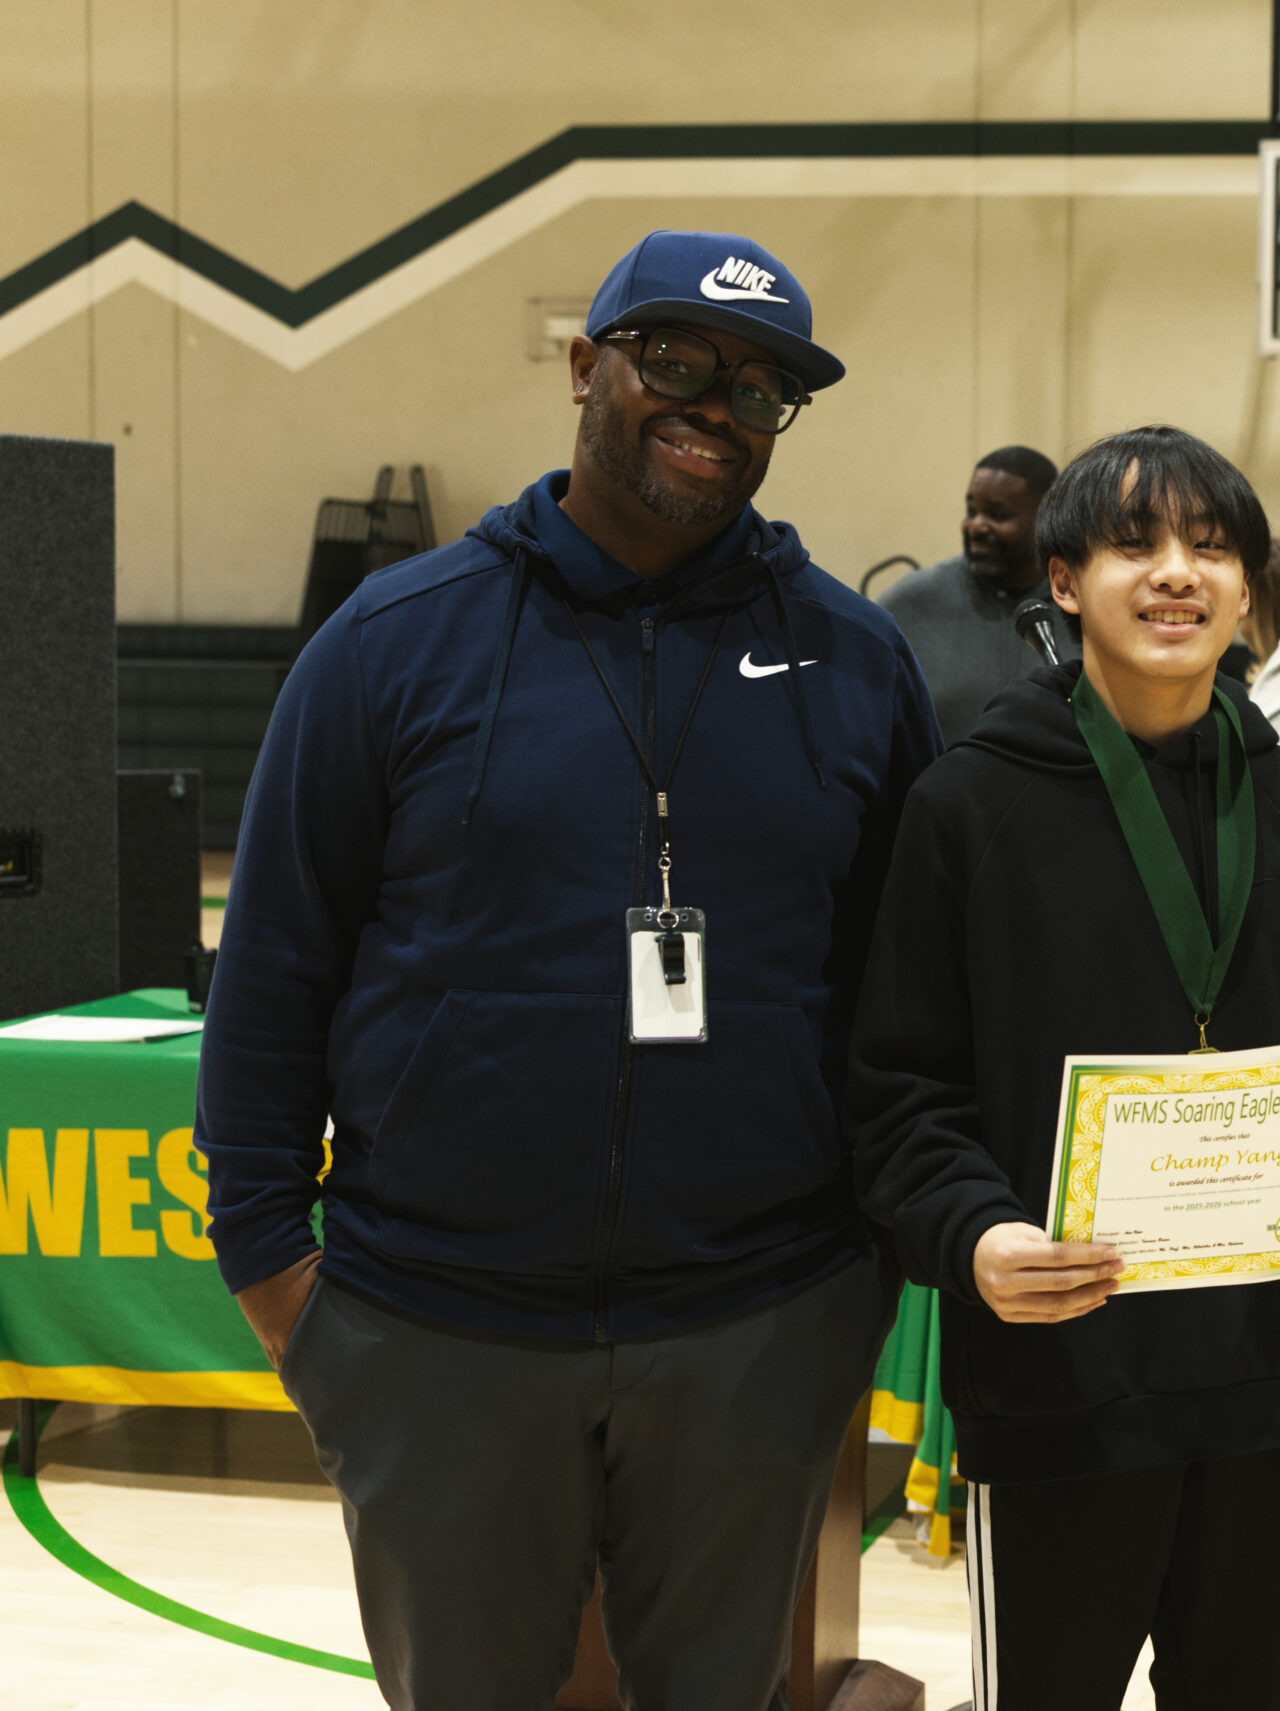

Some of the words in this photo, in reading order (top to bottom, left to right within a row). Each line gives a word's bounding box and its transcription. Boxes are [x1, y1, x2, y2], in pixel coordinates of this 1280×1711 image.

[716, 256, 776, 294] NIKE
[1113, 1099, 1168, 1124] WFMS
[1172, 1096, 1234, 1128] Soaring
[1199, 1135, 1212, 1143] This
[1212, 1133, 1236, 1142] certifies
[1237, 1131, 1250, 1140] that
[1150, 1151, 1230, 1173] Champ
[1176, 1177, 1205, 1187] awarded
[1205, 1176, 1218, 1184] this
[1219, 1174, 1252, 1184] certificate
[1252, 1172, 1264, 1181] for
[1185, 1201, 1222, 1211] 2025-2026
[1223, 1199, 1246, 1207] school
[1247, 1198, 1262, 1206] year
